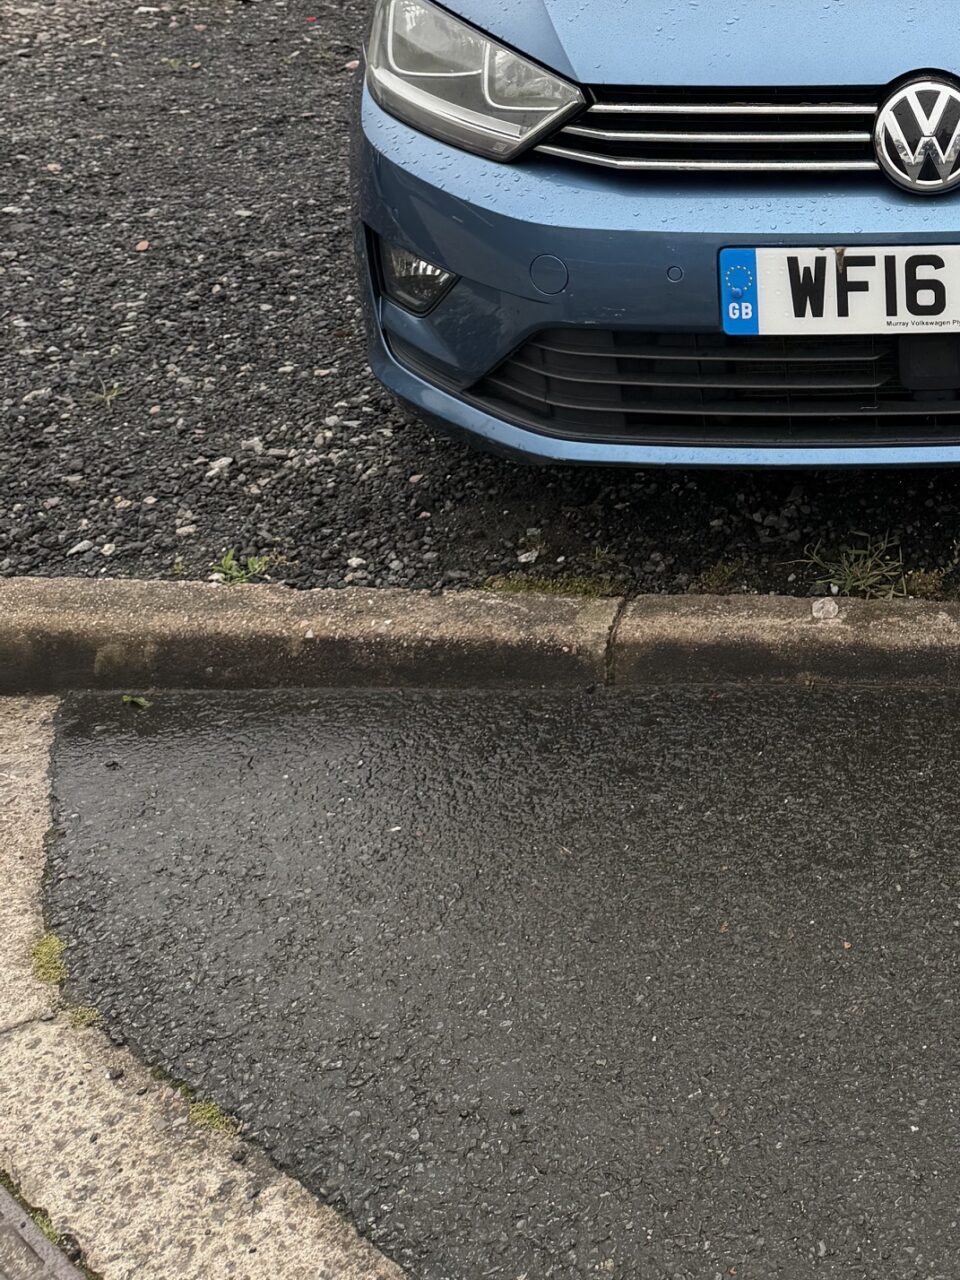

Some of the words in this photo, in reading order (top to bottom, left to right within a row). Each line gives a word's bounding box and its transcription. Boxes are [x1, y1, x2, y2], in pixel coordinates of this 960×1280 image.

[786, 253, 947, 319] WF16
[728, 302, 753, 320] GB
[886, 320, 909, 328] Murray
[911, 319, 950, 327] Volkswagen
